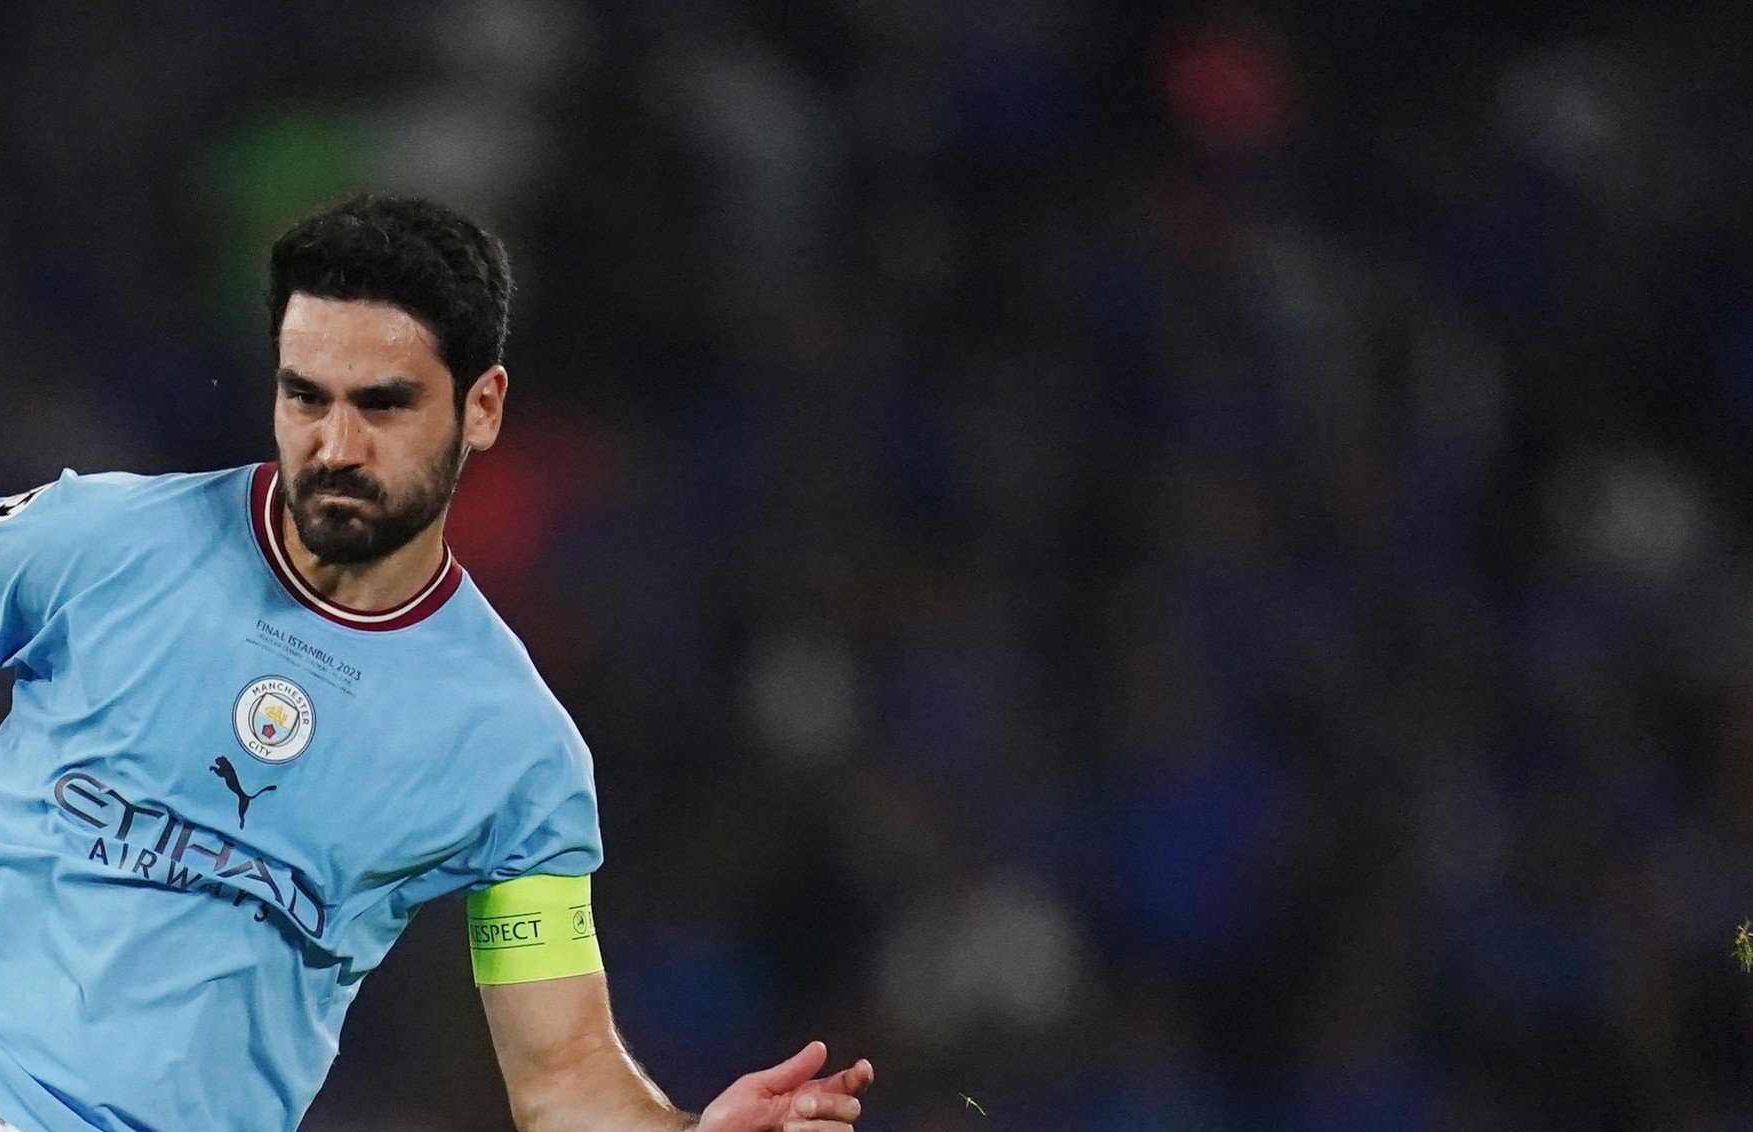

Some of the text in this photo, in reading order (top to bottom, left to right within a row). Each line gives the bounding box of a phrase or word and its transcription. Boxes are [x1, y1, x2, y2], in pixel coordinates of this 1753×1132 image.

[256, 619, 286, 641] FINAL
[288, 635, 335, 668] ISTANBUL
[337, 661, 362, 681] 2023
[252, 682, 310, 726] MANCHESTER
[248, 740, 272, 758] CITY
[54, 772, 325, 939] ETIHAD
